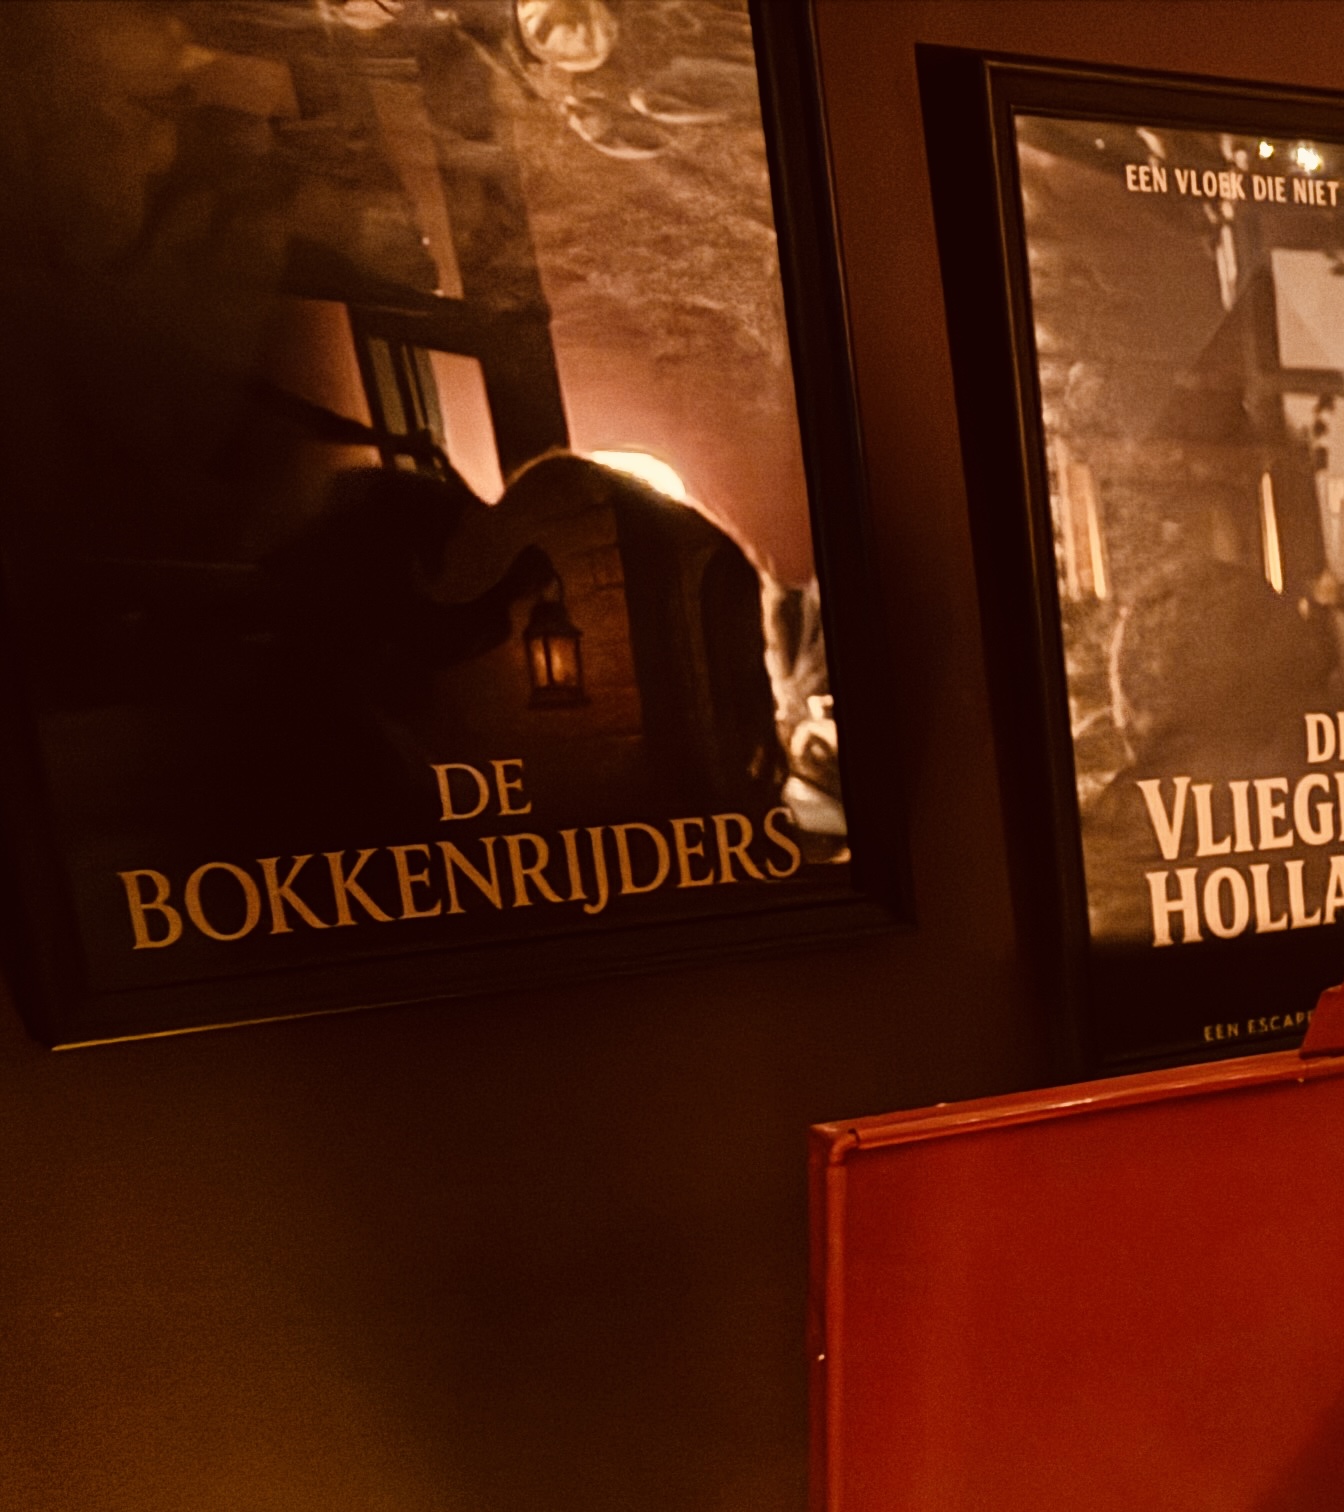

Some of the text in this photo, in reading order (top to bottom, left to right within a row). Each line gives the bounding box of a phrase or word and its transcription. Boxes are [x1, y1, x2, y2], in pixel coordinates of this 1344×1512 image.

[1126, 165, 1167, 194] EEN
[1175, 168, 1246, 200] VLOEK
[1252, 175, 1287, 203] DIE
[1293, 178, 1339, 208] NIET
[430, 759, 532, 821] DE
[118, 806, 801, 950] BOKKENRIJDERS
[1203, 1022, 1239, 1042] EEN
